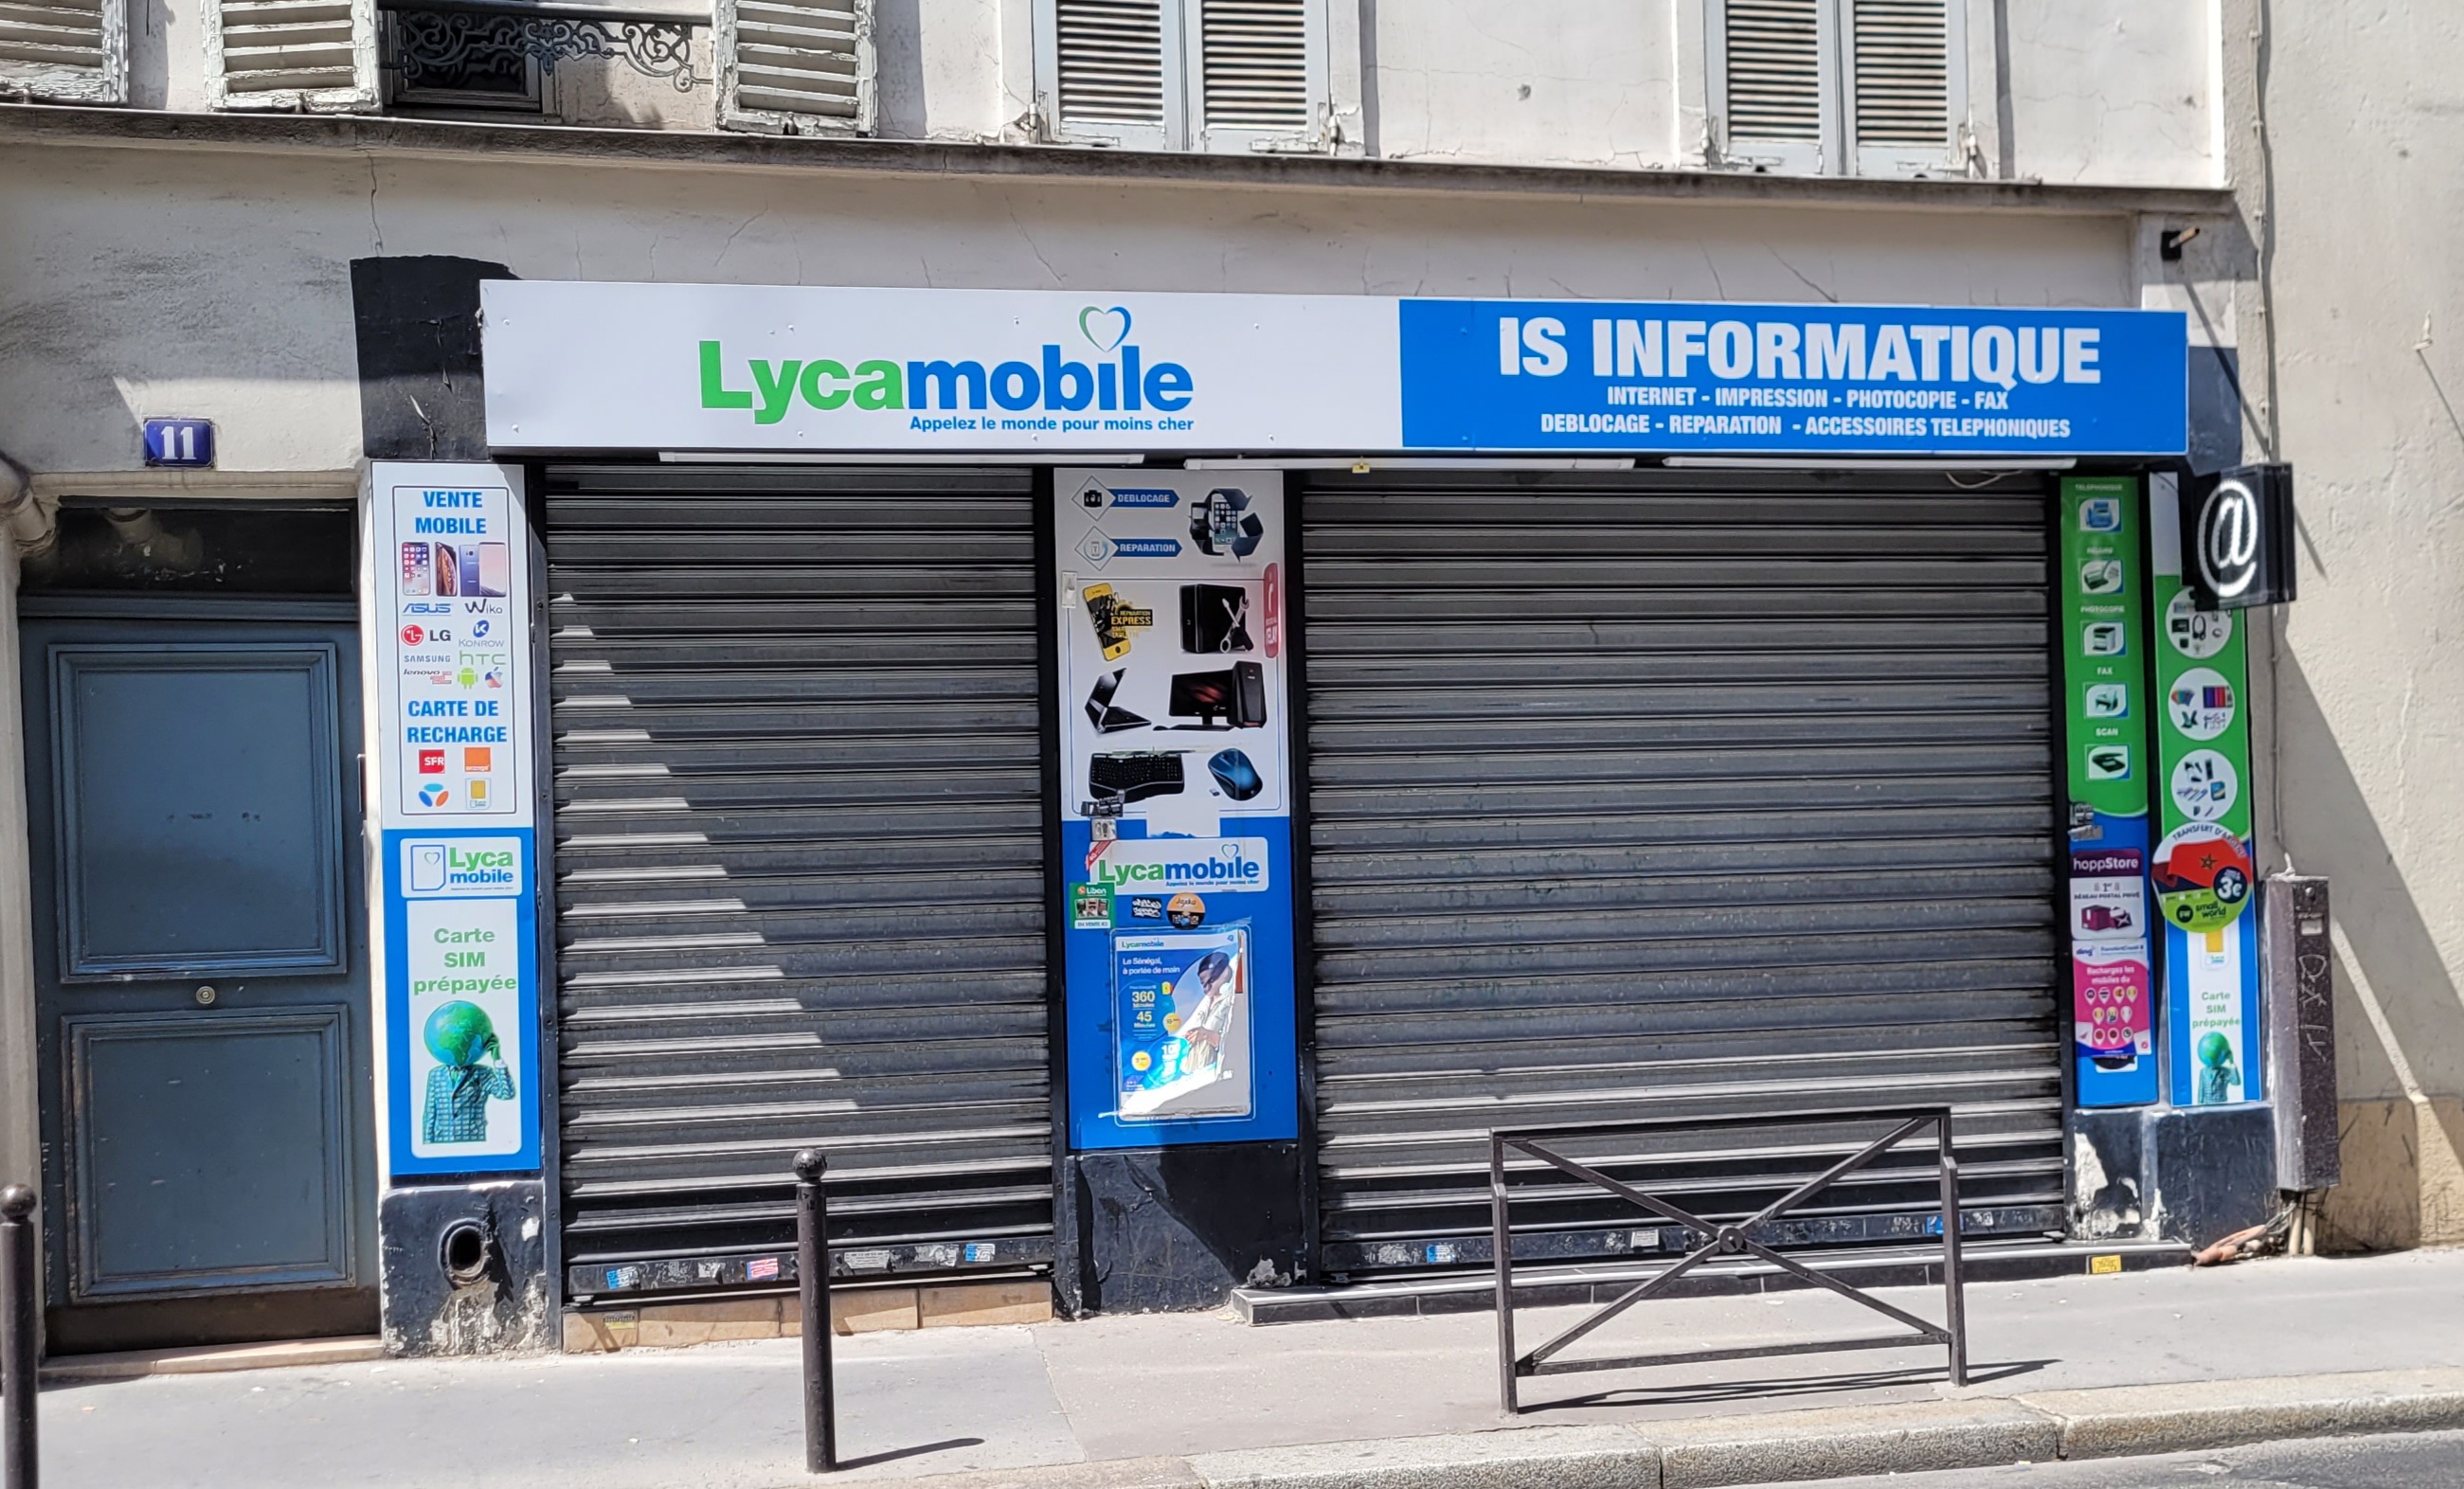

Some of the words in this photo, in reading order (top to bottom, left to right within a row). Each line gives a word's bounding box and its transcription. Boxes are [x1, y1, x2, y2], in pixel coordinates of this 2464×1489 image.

[1500, 317, 1568, 376] IS
[1592, 319, 2101, 391] INFORMATIQUE
[698, 338, 1194, 424] Lycamobile
[1608, 386, 1697, 406] INTERNET
[1715, 387, 1827, 408] IMPRESSION
[1846, 388, 1956, 409] PHOTOCOPIE
[1974, 390, 2008, 410] FAX
[909, 416, 977, 433] Appelez
[981, 416, 997, 431] le
[1001, 417, 1057, 431] monde
[1062, 419, 1099, 433] pour
[1104, 417, 1154, 431] moins
[1158, 417, 1195, 432] cher
[1540, 414, 1650, 433] DEBLOCAGE
[1669, 415, 1781, 435] REPARATION
[1806, 416, 1927, 437] ACCESSOIRES
[1930, 417, 2071, 439] TELEPHONIQUES
[161, 425, 197, 459] 11
[423, 491, 483, 509] VENTE
[1118, 494, 1170, 503] DEBLOCAGE
[415, 517, 487, 534] MOBILE
[1120, 544, 1176, 553] REPARATION
[403, 602, 451, 614] ASUS
[1110, 616, 1152, 625] EXPRESS
[429, 630, 452, 641] LG
[459, 638, 505, 648] KONROW
[404, 655, 451, 663] SAMSUNG
[2097, 667, 2113, 675] FAX
[407, 700, 469, 718] CARTE
[475, 700, 499, 717] DE
[407, 726, 508, 744] RECHARGE
[2095, 727, 2118, 736] SCAN
[424, 757, 444, 766] SFR
[2172, 823, 2214, 841] TRANSFERT
[449, 847, 513, 871] Lyca
[2073, 856, 2139, 872] hoppStore
[450, 869, 513, 884] mobile
[1098, 856, 1260, 886] Lycamobile
[434, 927, 495, 944] Carte
[443, 951, 486, 968] SIM
[413, 975, 517, 996] prépayée
[1132, 991, 1156, 1002] 360
[2202, 992, 2231, 1000] Carte
[1136, 1011, 1153, 1022] 45
[2205, 1004, 2226, 1014] SIM
[2192, 1016, 2240, 1030] prépayée
